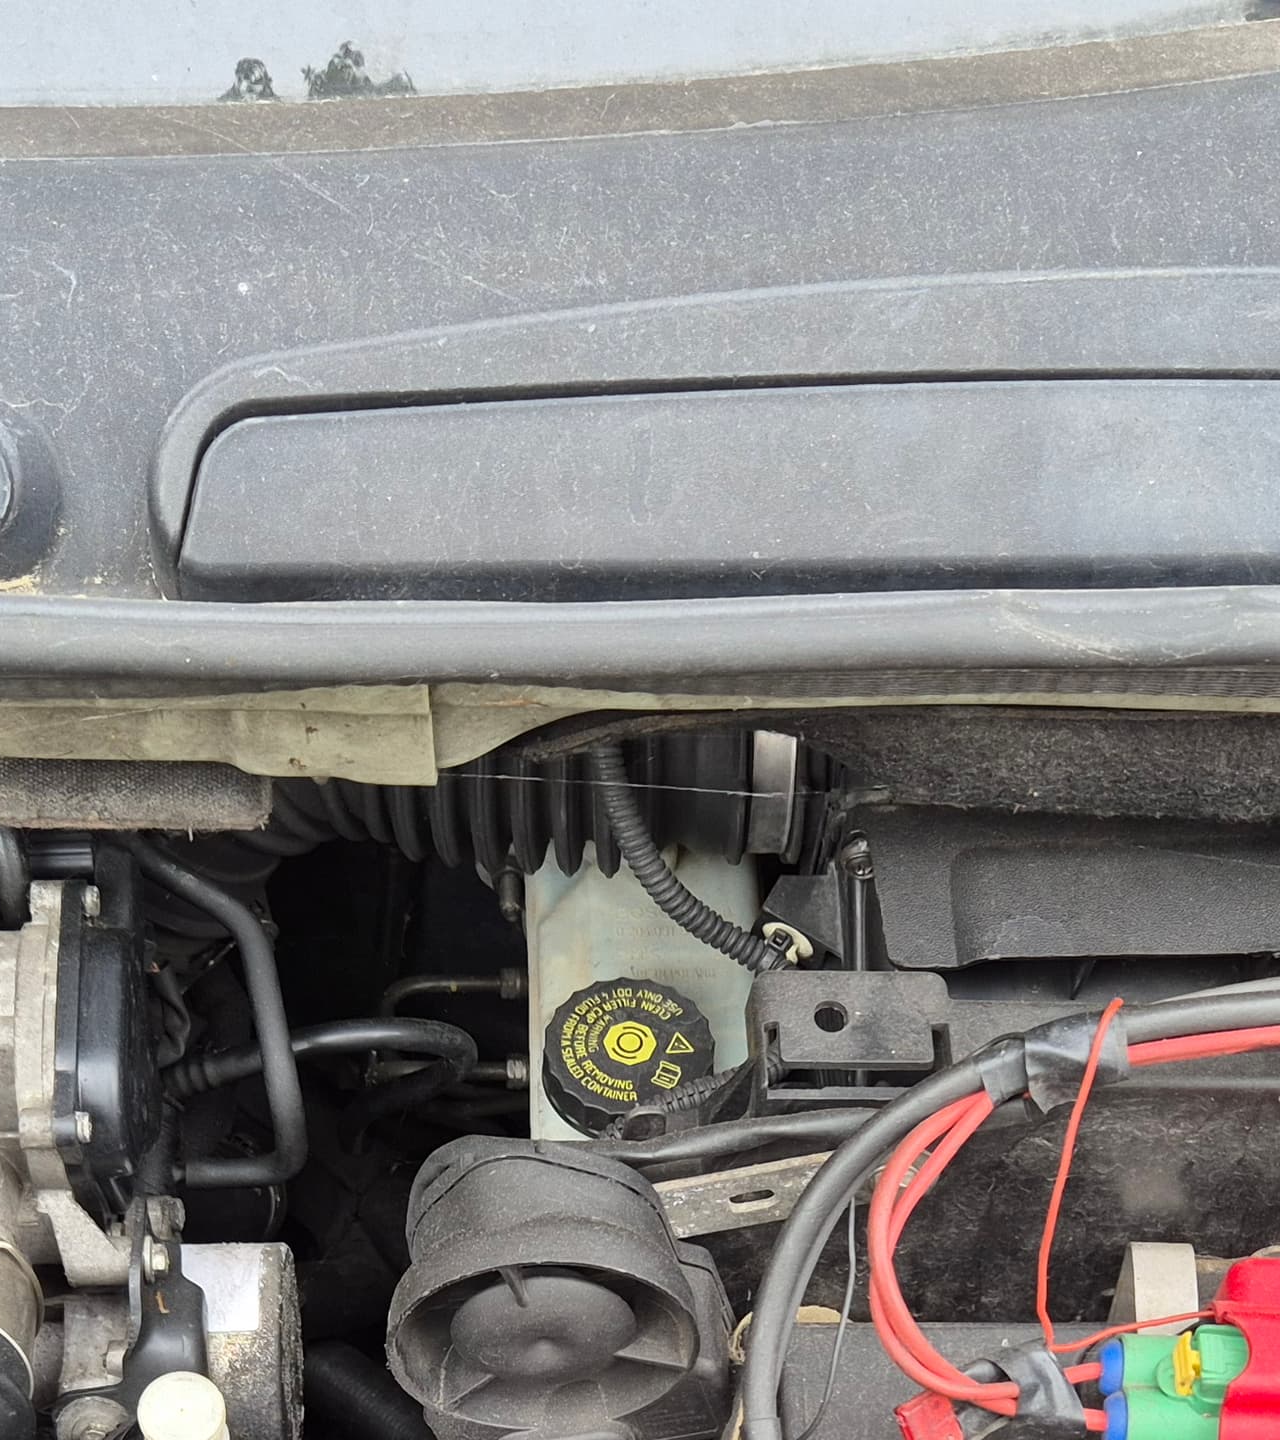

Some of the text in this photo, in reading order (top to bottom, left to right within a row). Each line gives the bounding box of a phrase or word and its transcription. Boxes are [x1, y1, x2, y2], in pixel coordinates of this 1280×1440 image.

[560, 987, 684, 1102] USE ONLY DOT 4 FLUID FROM A SEALED CONTAINER
[573, 998, 672, 1091] CLEAN FILLER CAP BEFORE REMOVING
[587, 1014, 615, 1053] WARNING
